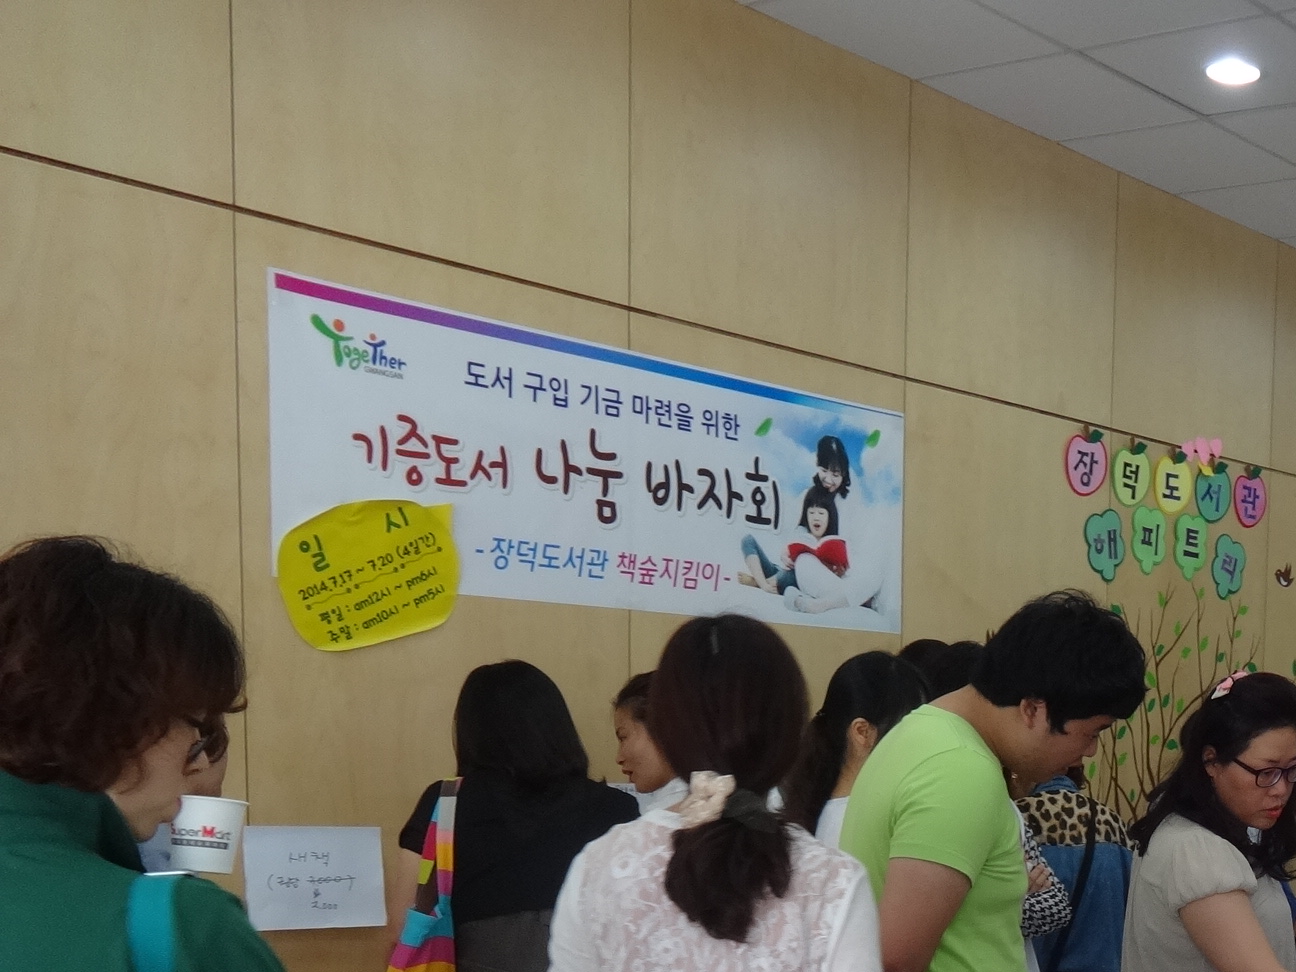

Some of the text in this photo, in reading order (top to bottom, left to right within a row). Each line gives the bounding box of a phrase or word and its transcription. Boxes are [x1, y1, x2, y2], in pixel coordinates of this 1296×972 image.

[465, 361, 741, 441] 도서 구입 기금 마련을 위한
[352, 413, 781, 530] 기증도서 나눔 바자회
